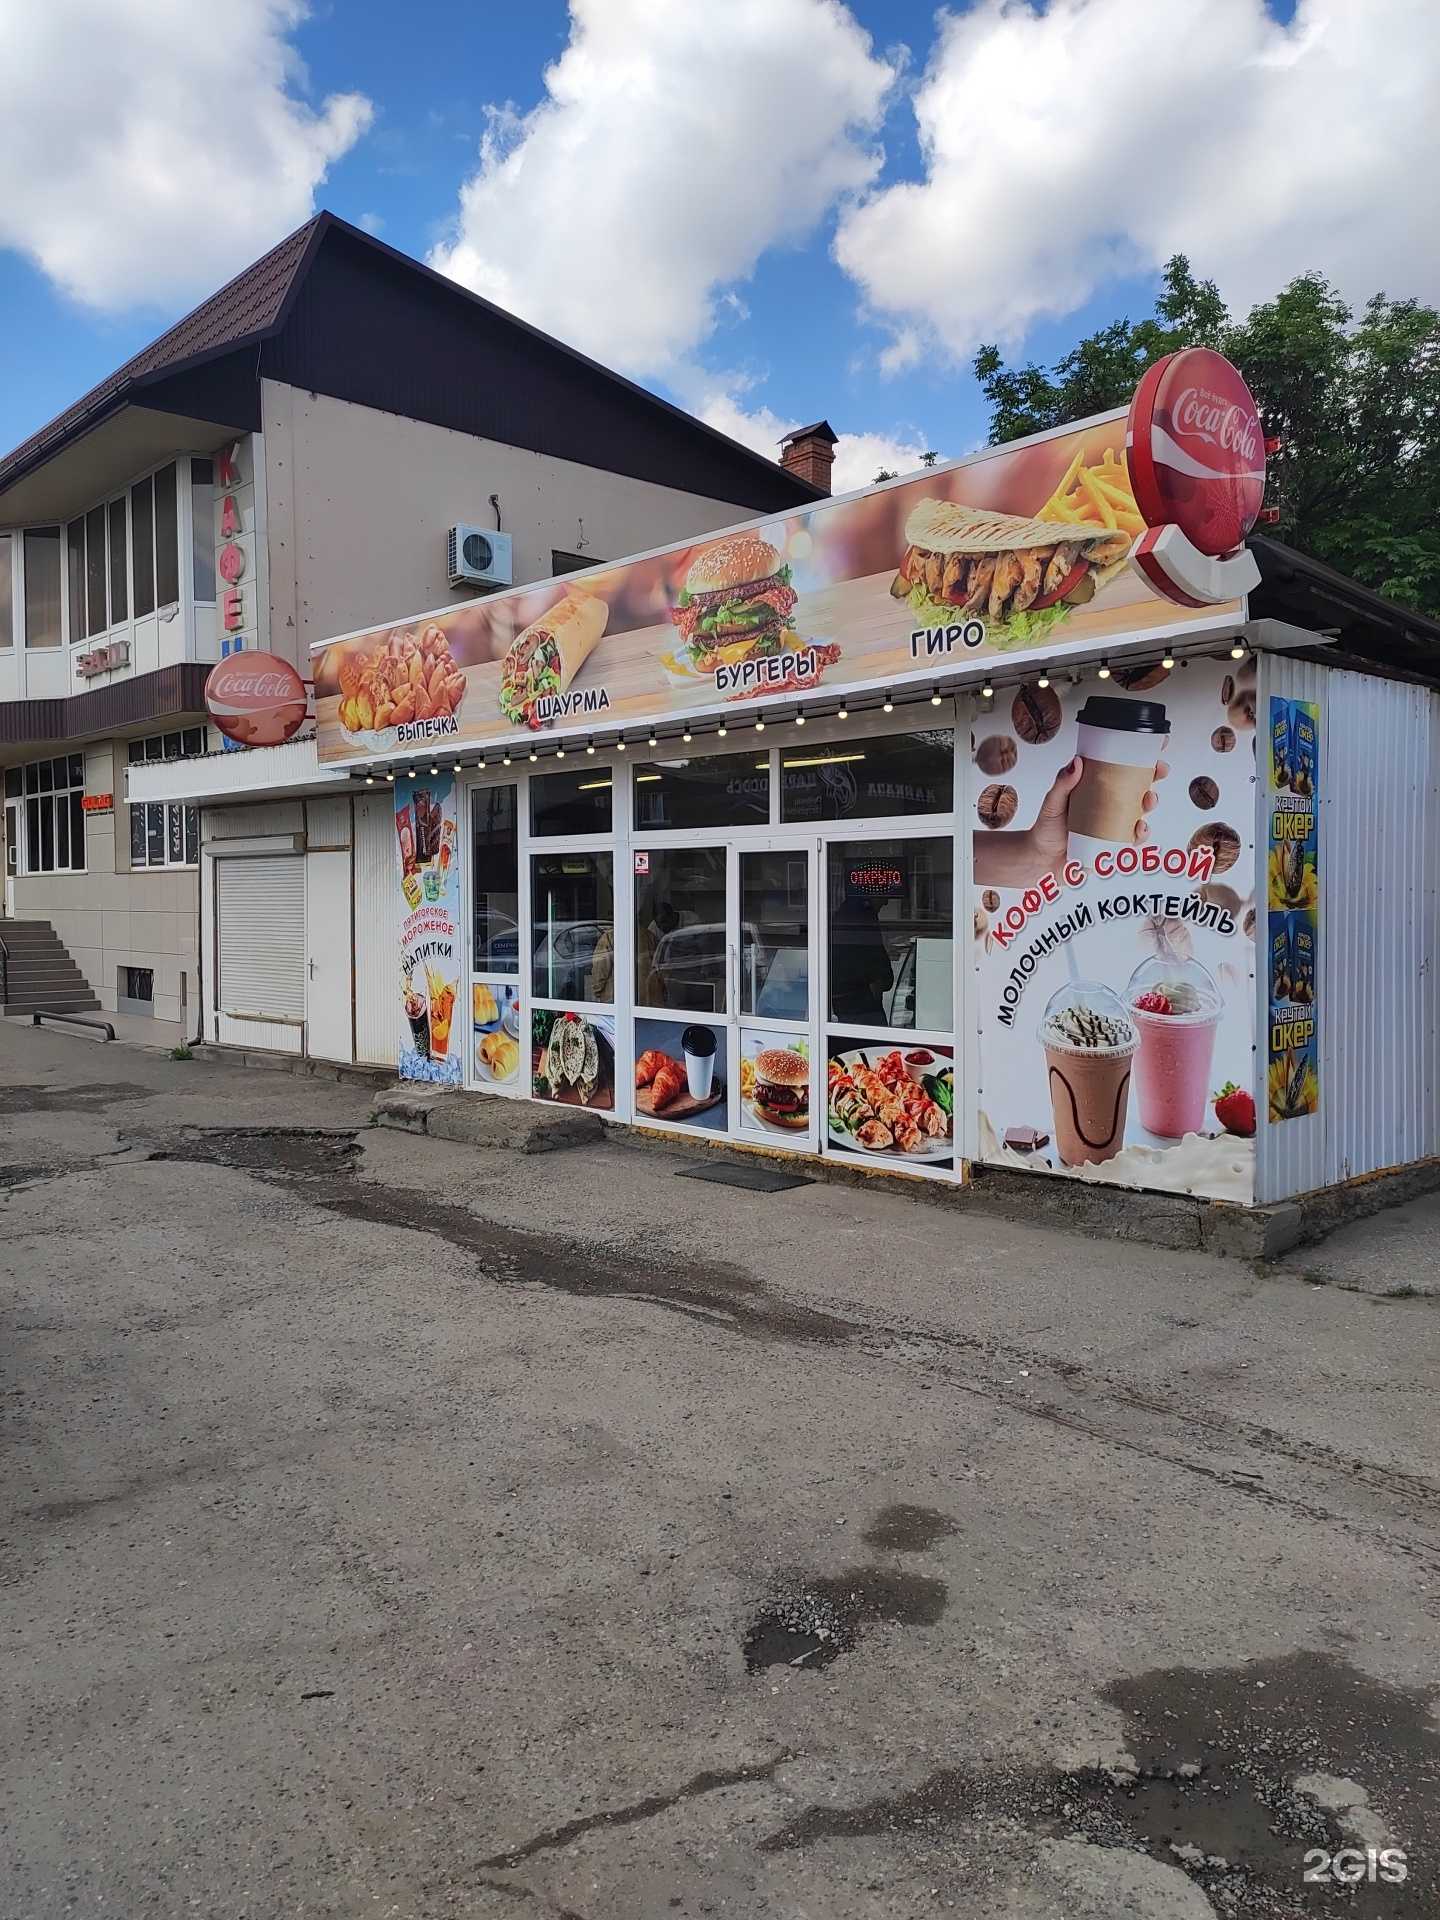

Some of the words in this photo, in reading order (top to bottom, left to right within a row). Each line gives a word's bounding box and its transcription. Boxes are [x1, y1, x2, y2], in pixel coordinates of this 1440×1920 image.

[1172, 388, 1259, 460] Coca-Cola
[219, 439, 246, 632] КАФЕ
[911, 621, 984, 658] ГИРО
[215, 672, 294, 699] Coca-Cola
[715, 651, 816, 690] БУРГЕРЫ
[537, 688, 610, 719] ШАУРМА
[397, 716, 459, 742] ВЫПЕЧКА
[1275, 796, 1312, 812] КРУТОЙ
[850, 870, 901, 884] ОТКРЫТО
[991, 875, 1060, 947] КОФЕ
[1064, 861, 1084, 887] С
[1094, 846, 1215, 882] СОБОЙ
[402, 905, 449, 930] ПЯТИГОРСКОЕ
[401, 920, 455, 947] МОРОЖЕНОЕ
[402, 941, 453, 975] НАПИТКИ
[997, 902, 1093, 1026] МОЛОЧНЫЙ
[1098, 894, 1236, 935] КОКТЕЙЛЬ
[1275, 1005, 1313, 1024] КРУТОЙ
